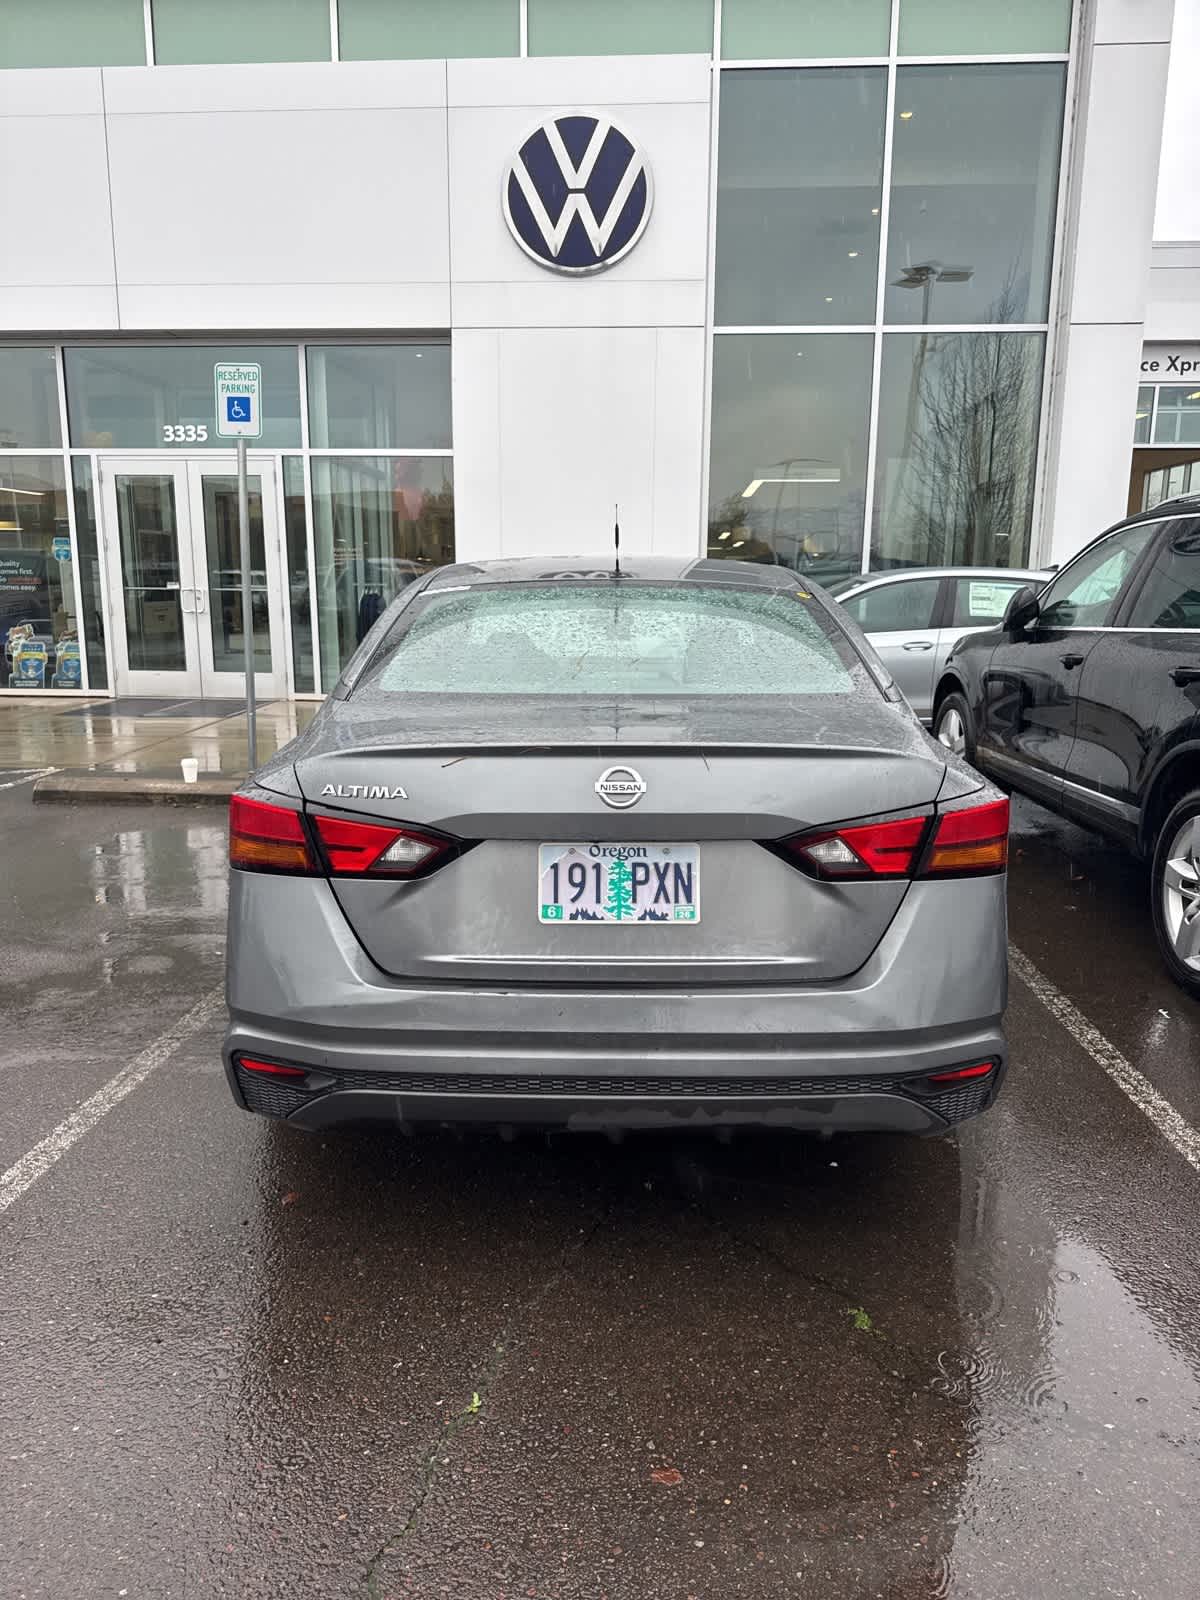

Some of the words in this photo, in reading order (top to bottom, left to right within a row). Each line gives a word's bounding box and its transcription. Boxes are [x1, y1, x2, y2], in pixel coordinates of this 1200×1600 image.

[218, 371, 258, 381] RESERVED
[221, 383, 256, 394] PARKING
[163, 424, 208, 442] 3335
[321, 783, 408, 800] ALTIMA
[589, 844, 648, 861] Oregon
[550, 862, 601, 904] 191
[631, 862, 693, 904] PXN
[547, 907, 556, 918] 6
